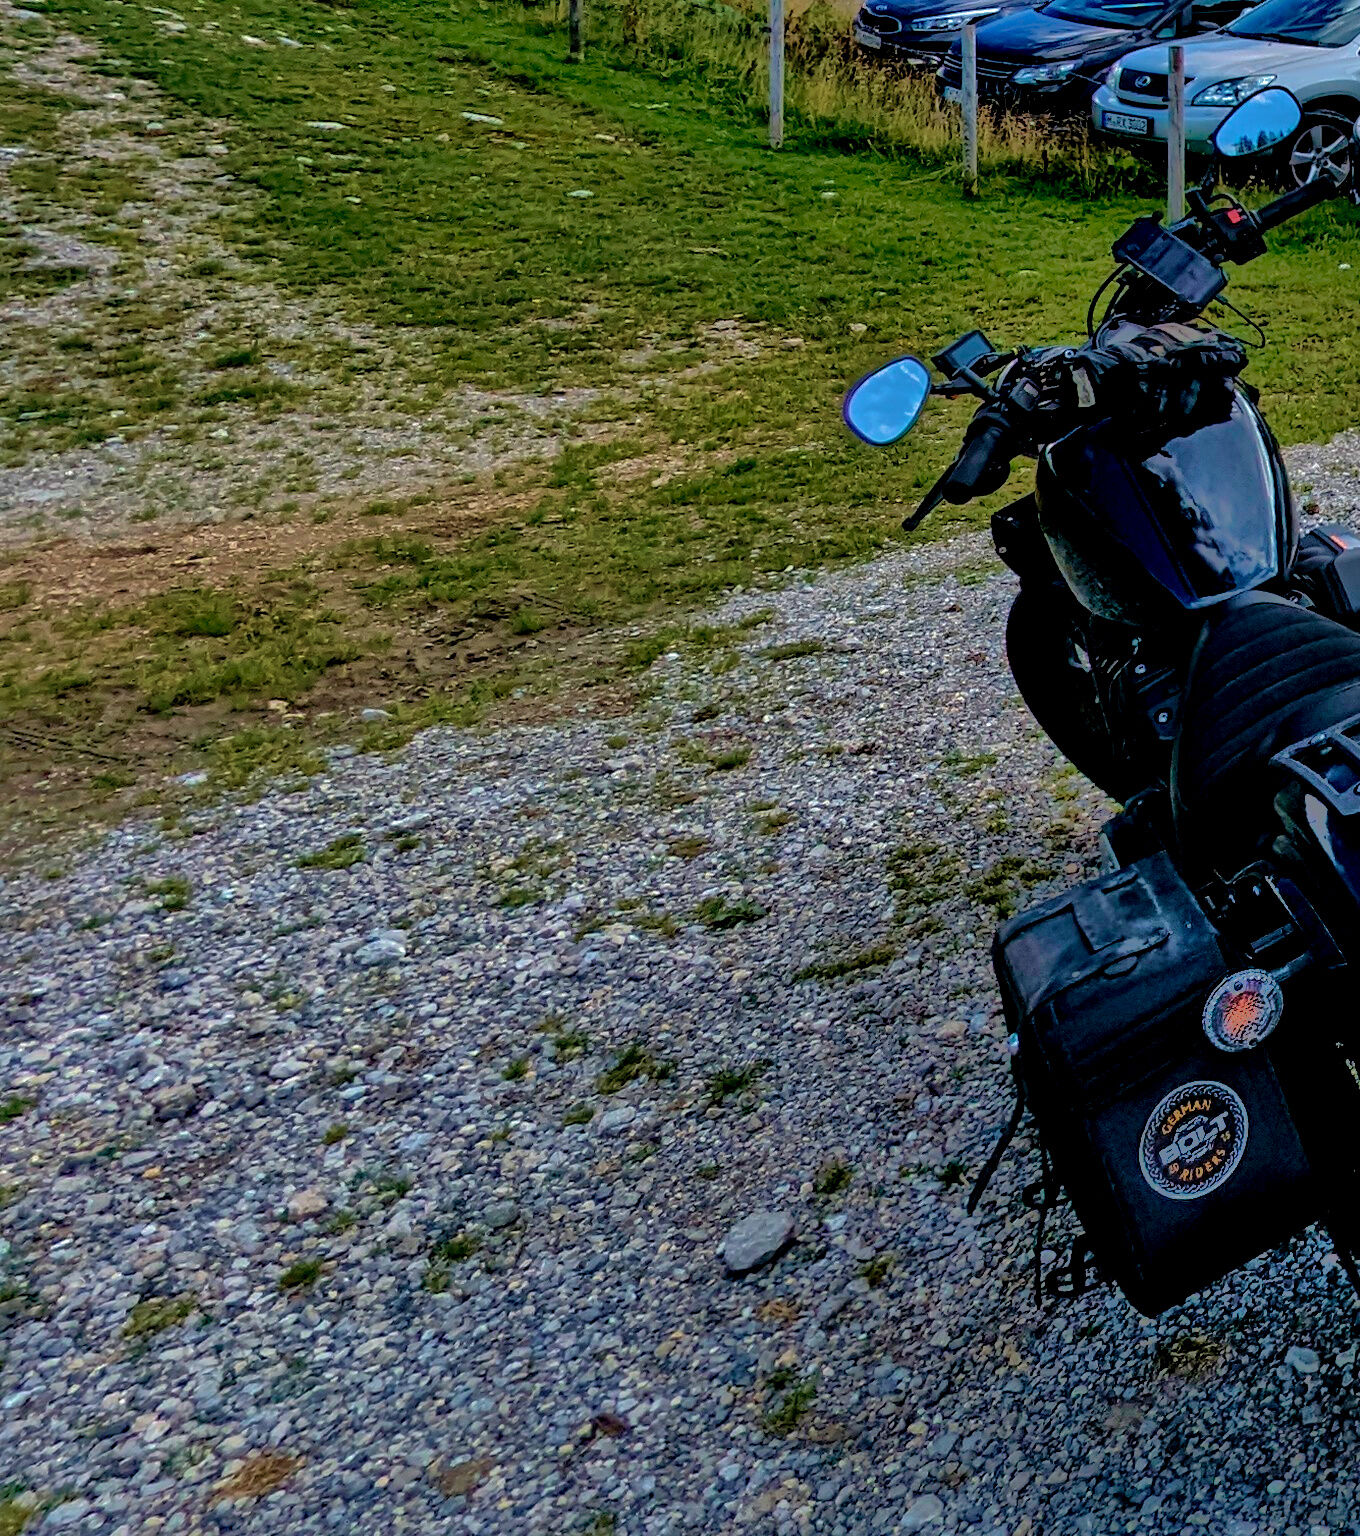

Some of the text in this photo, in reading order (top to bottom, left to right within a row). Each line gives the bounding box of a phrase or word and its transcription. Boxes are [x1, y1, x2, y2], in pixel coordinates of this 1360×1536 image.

[1161, 1099, 1212, 1135] GERMAN
[1159, 1111, 1229, 1165] BOLT
[1178, 1149, 1226, 1182] RIDERS
